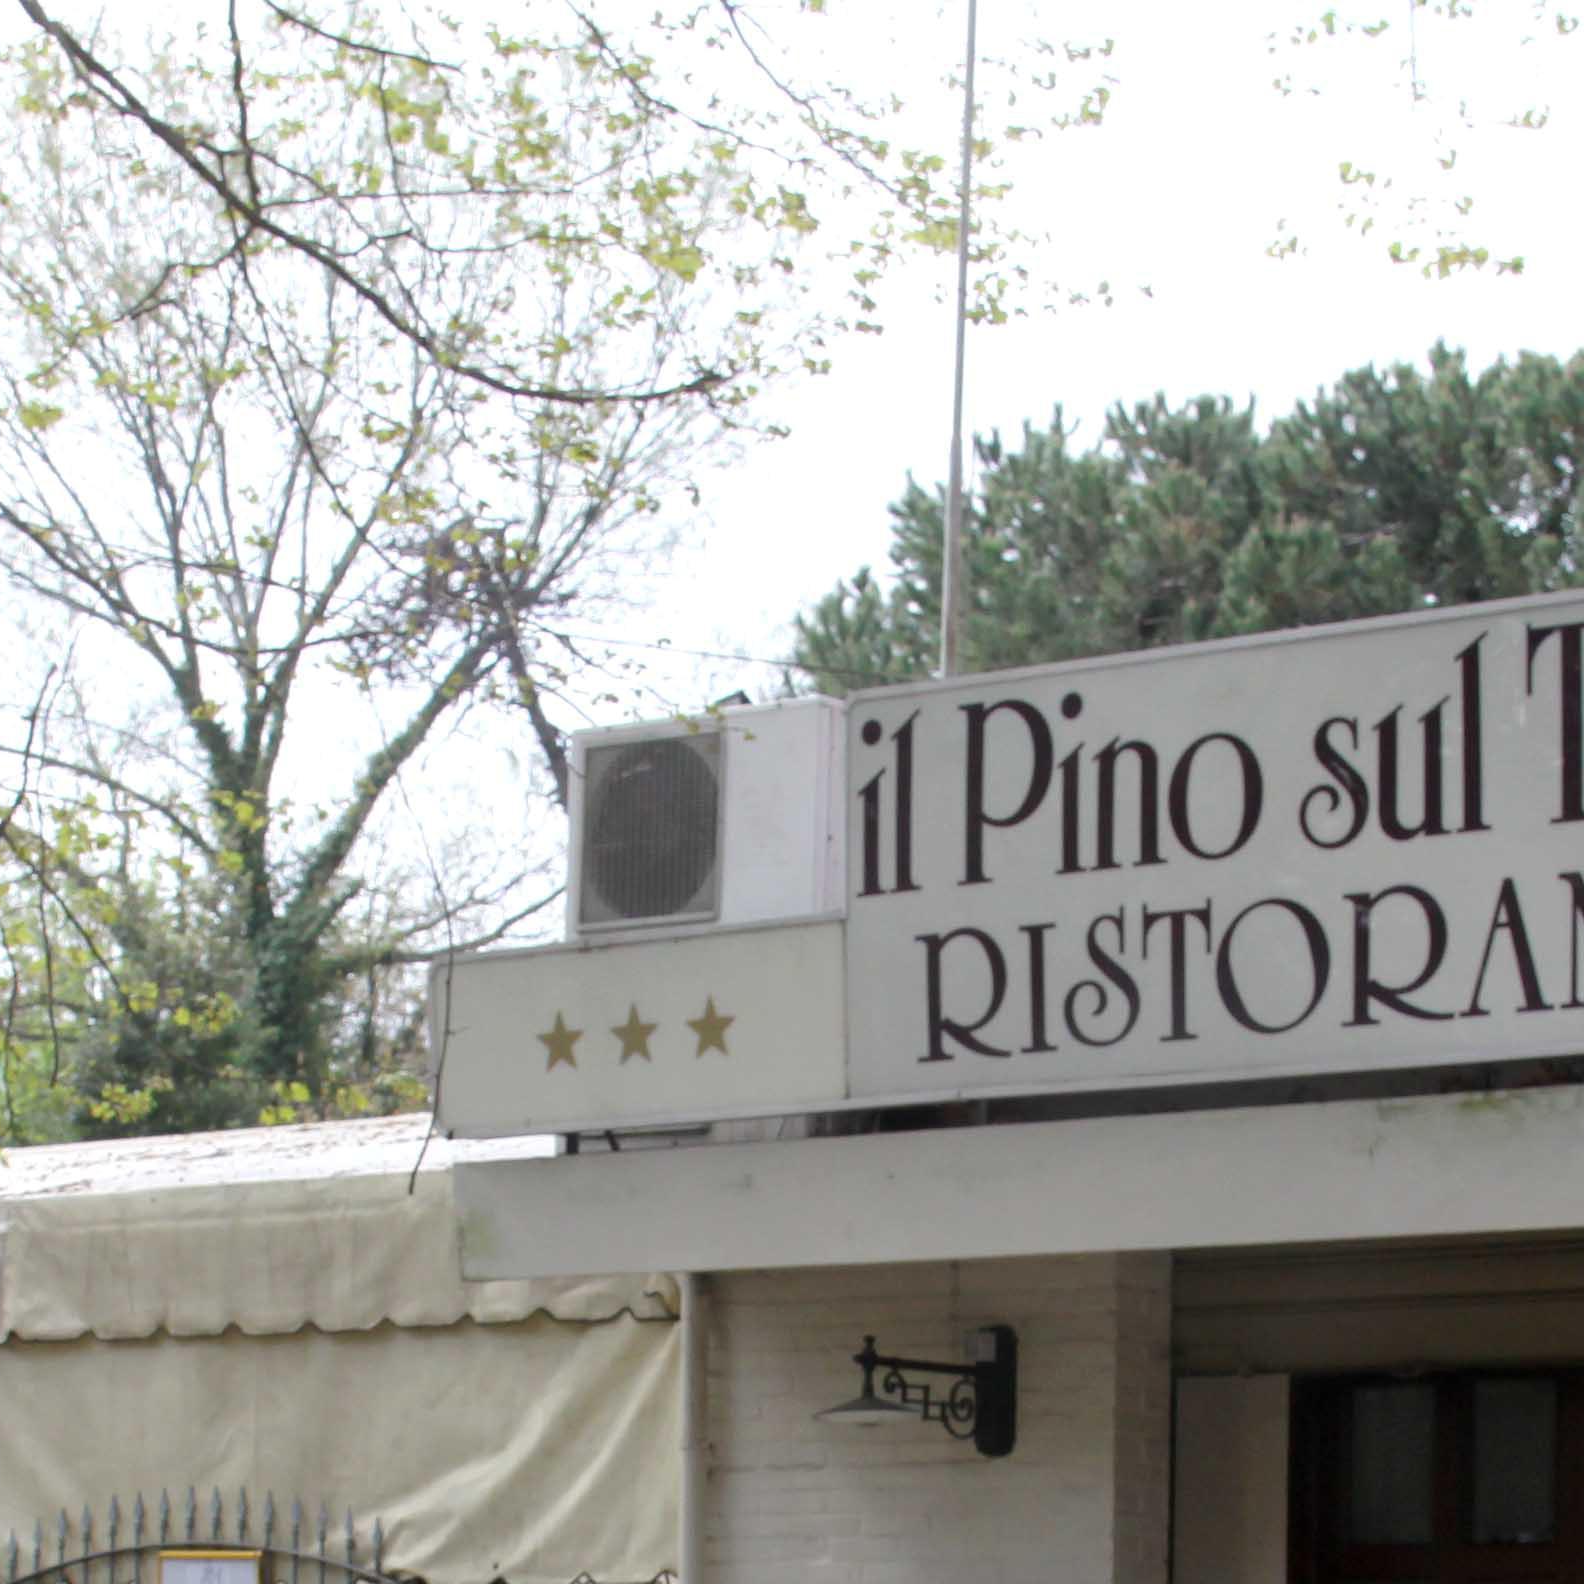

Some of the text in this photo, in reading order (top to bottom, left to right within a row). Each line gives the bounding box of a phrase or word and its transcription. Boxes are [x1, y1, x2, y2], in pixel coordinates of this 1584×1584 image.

[857, 718, 921, 897] il
[958, 691, 1264, 886] Pino
[1298, 632, 1491, 849] sul
